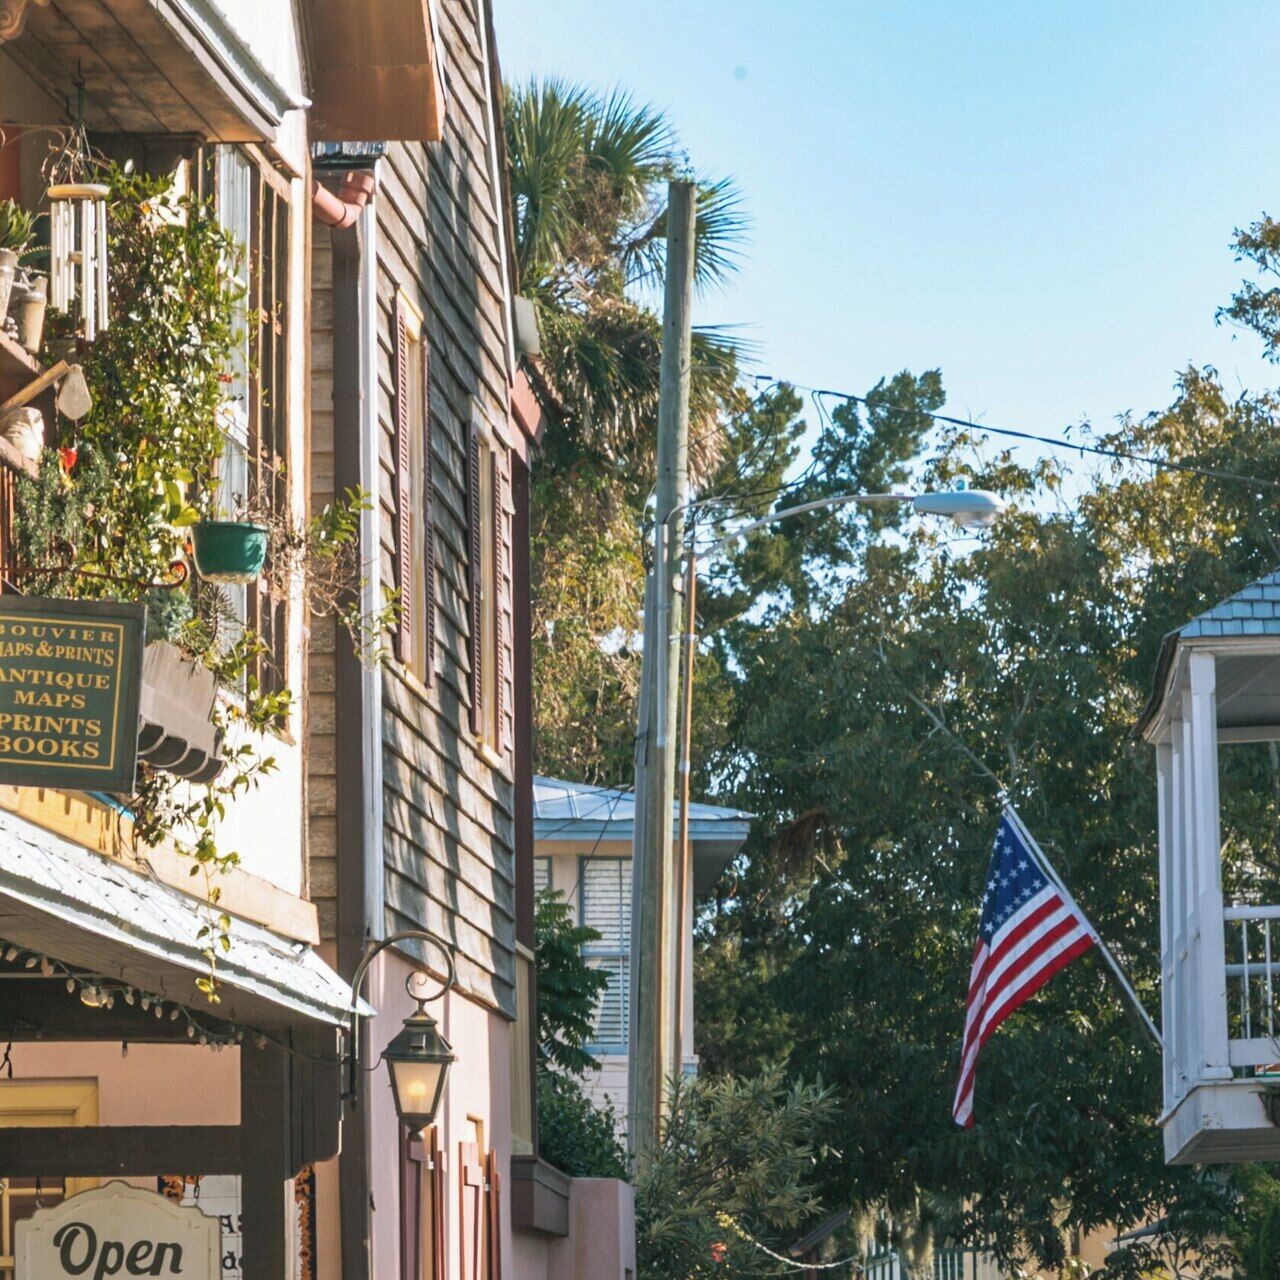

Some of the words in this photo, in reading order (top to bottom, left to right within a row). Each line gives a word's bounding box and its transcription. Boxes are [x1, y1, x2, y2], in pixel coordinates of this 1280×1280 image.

[36, 640, 53, 657] &
[55, 645, 114, 667] PRINTS
[13, 690, 86, 709] MAPS
